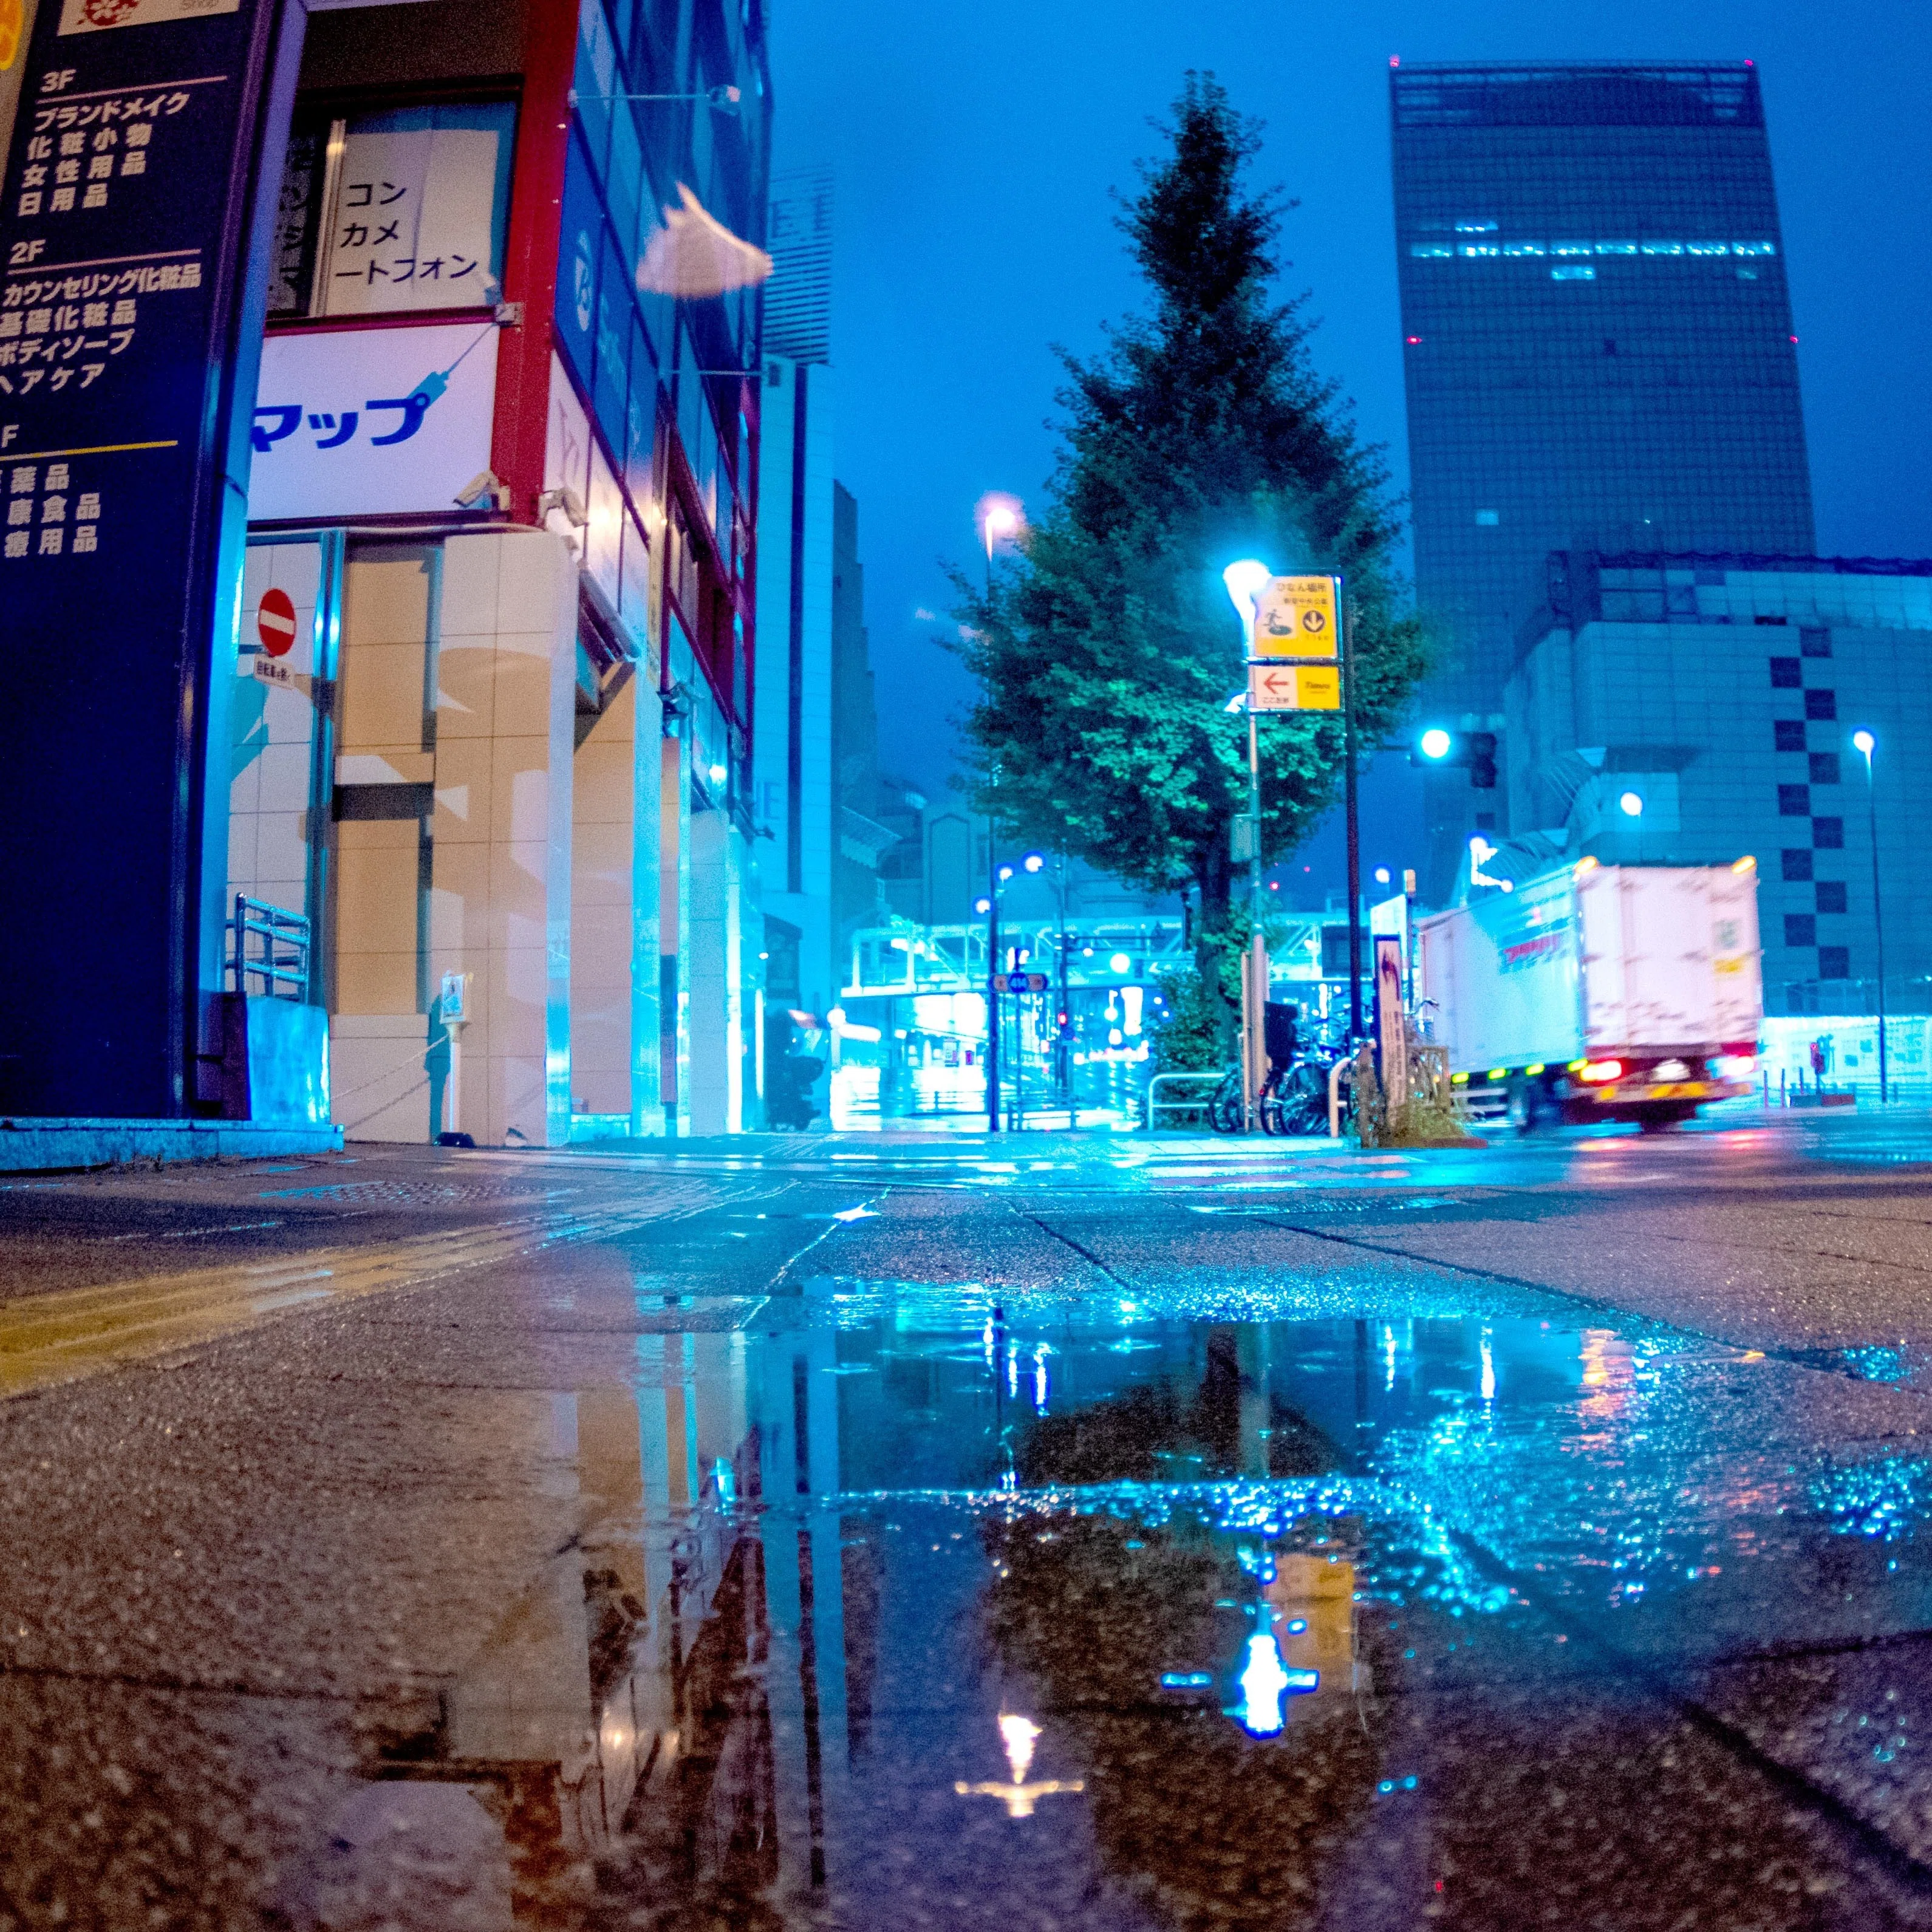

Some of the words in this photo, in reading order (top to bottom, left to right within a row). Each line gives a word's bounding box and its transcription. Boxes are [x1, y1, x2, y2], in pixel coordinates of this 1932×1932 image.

[40, 69, 77, 92] 3F
[21, 151, 146, 189] 女性用品
[18, 183, 108, 217] 日用品
[346, 182, 408, 207] コン
[340, 219, 399, 248] カメ
[9, 239, 46, 265] 2F
[2, 262, 202, 307] カウンセリング化粧品
[250, 392, 430, 452] マップ
[0, 463, 70, 494] 薬品
